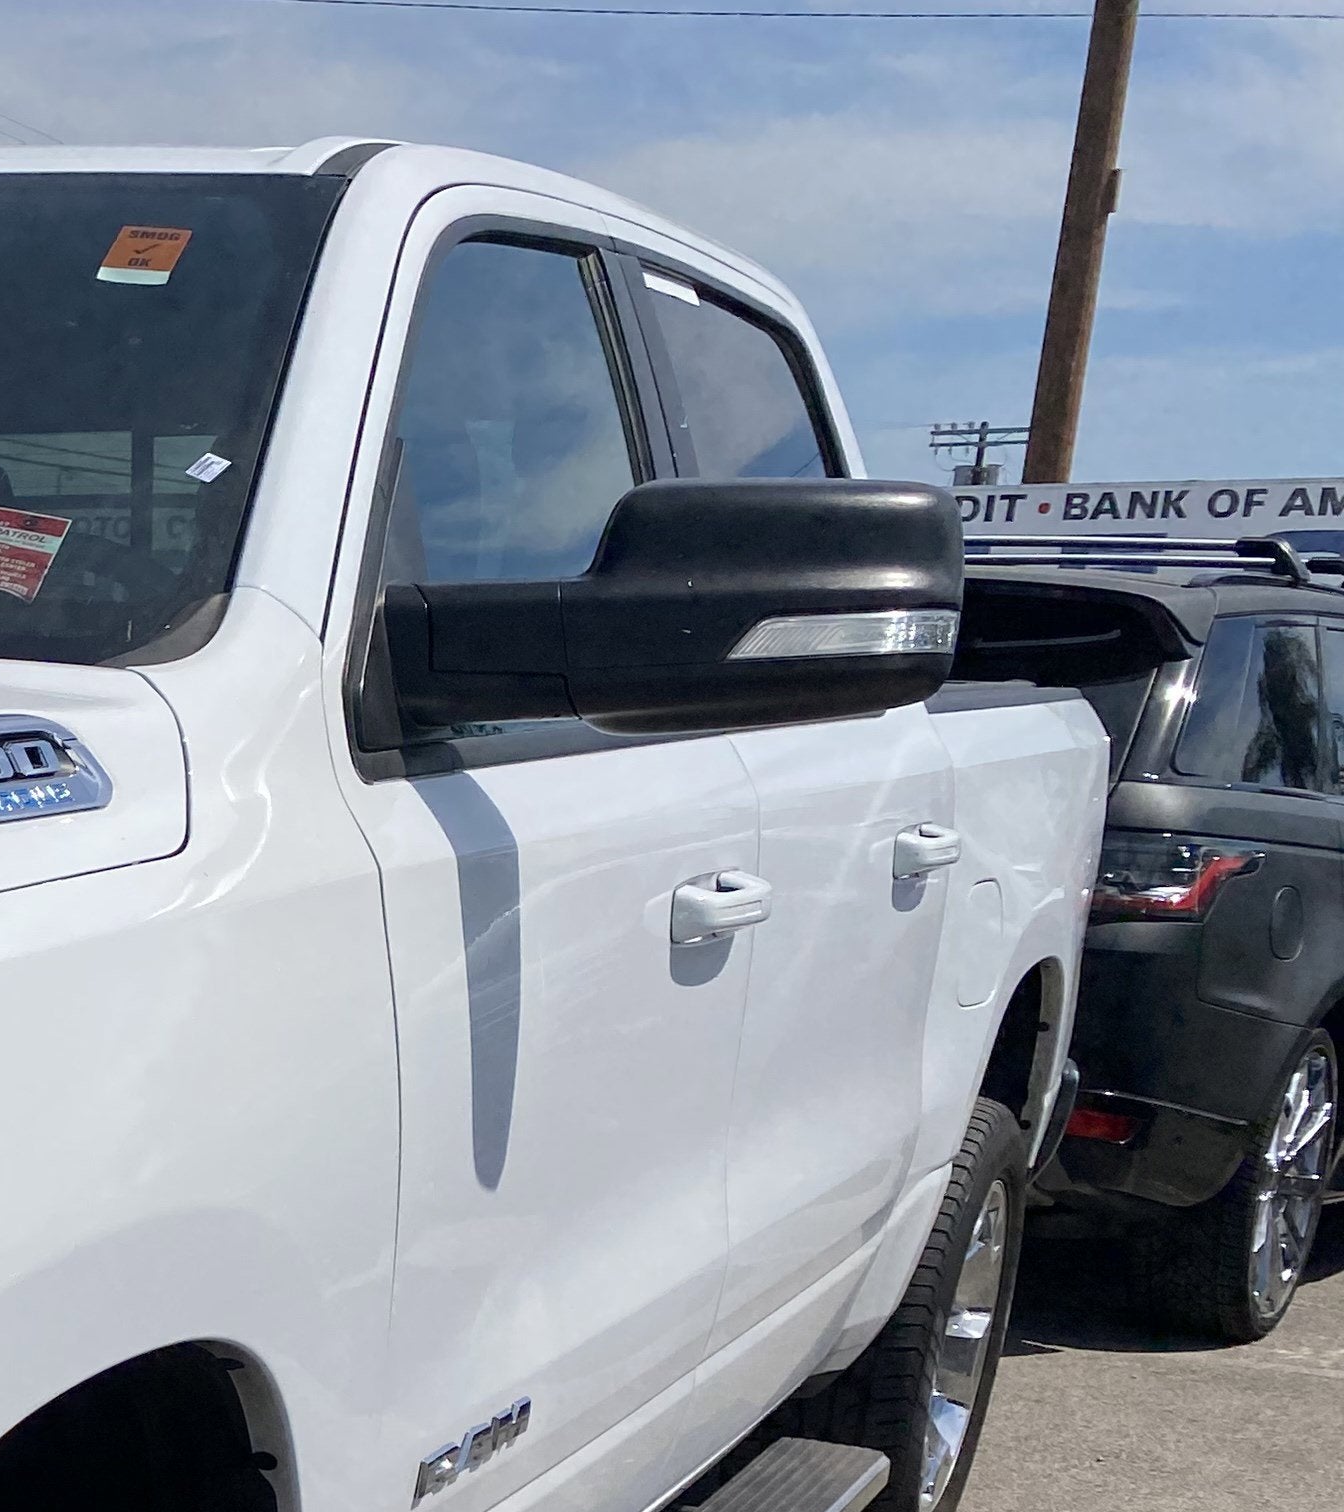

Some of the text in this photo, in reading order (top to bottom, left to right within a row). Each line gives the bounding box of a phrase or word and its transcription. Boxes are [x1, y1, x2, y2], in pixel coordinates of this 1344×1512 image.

[128, 229, 181, 241] SMOG
[128, 257, 152, 267] OK
[1062, 489, 1190, 521] BANK
[1207, 488, 1269, 518] OF
